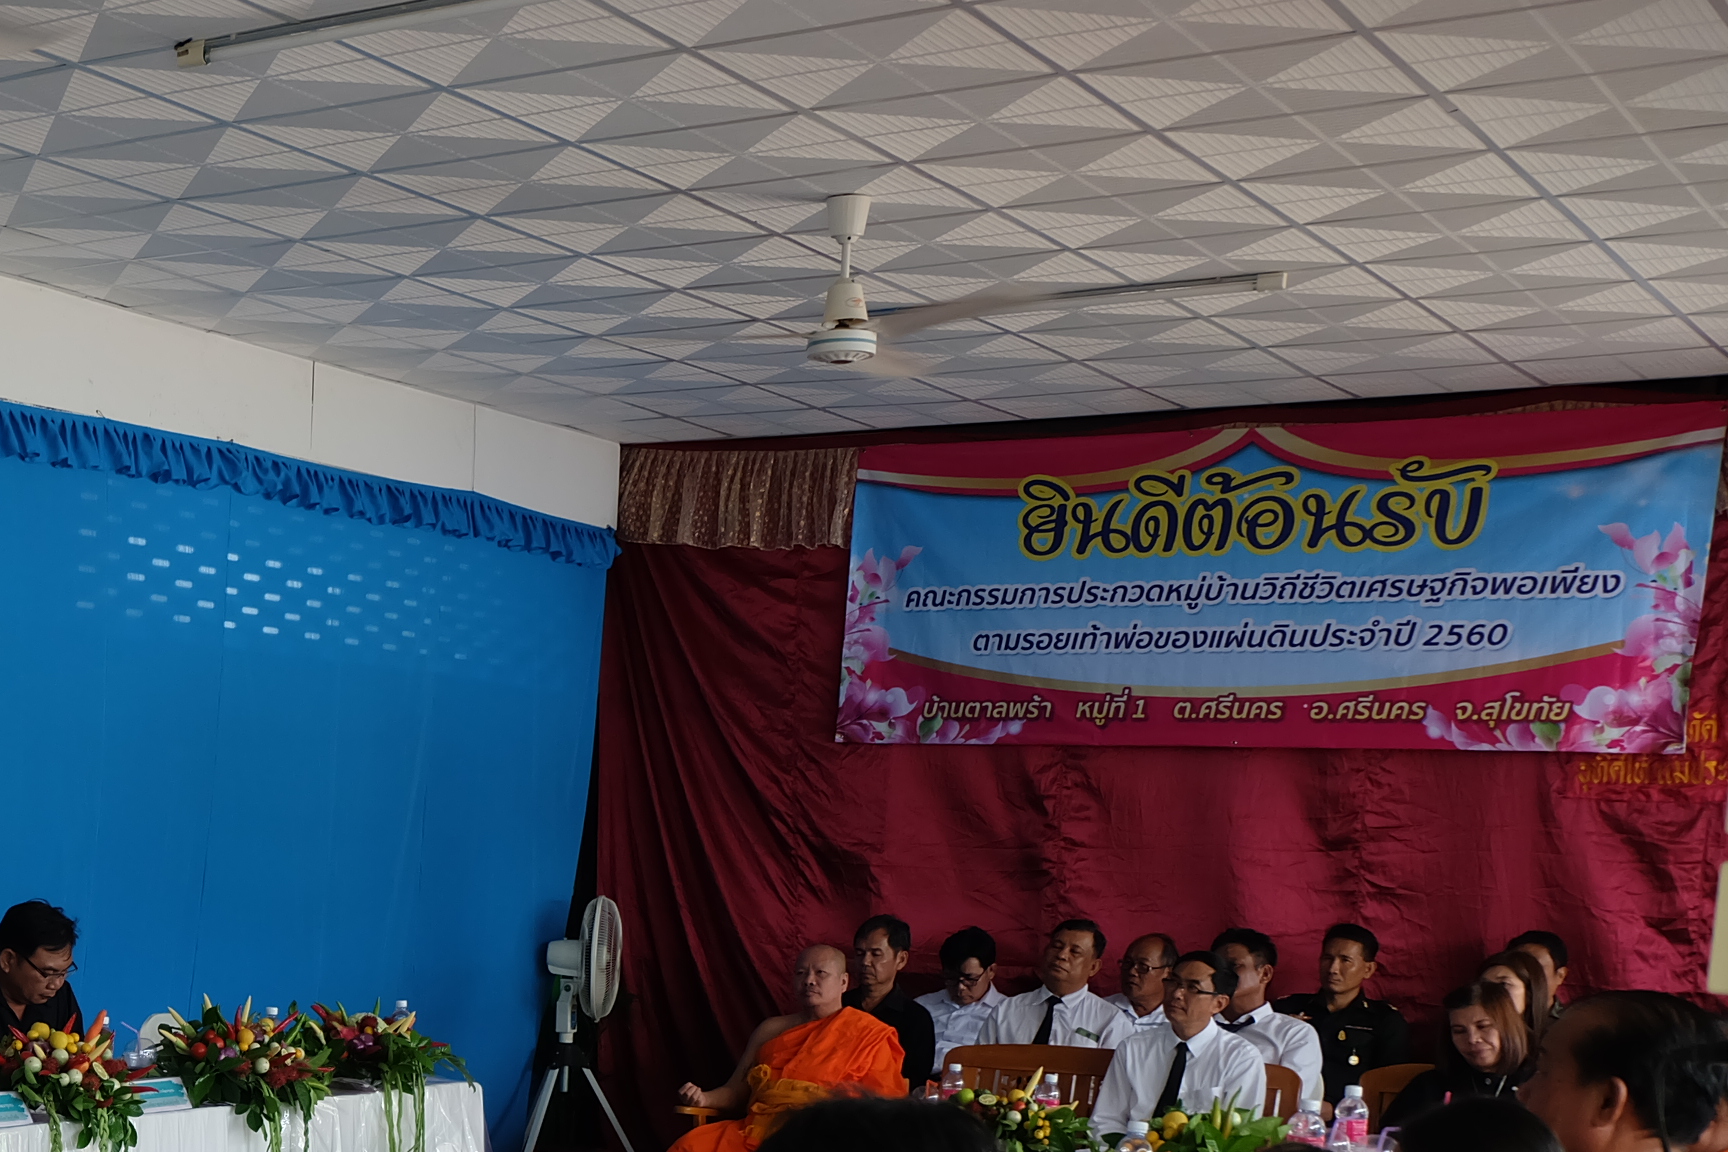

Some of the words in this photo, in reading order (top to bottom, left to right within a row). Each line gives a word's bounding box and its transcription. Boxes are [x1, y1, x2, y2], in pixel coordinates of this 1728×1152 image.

[1018, 455, 1499, 563] ยินดีต้อนรับ
[904, 563, 1625, 614] คณะกรรมการประกวดหมู่บ้านวิถีชีวิตเศรษฐกิจพอเพียง
[971, 617, 1418, 656] ตามรอยเท้าพ่อของแผ่นดินประจำปี
[1421, 621, 1512, 650] 2560
[922, 693, 1053, 722] บ้านตาลพร้า
[1076, 688, 1129, 726] หมู่ที่
[1131, 698, 1146, 720] 1
[1172, 694, 1284, 722] ต.ศรีนคร
[1309, 693, 1427, 722] อ.ศรีนคร
[1454, 692, 1572, 729] จ.สุโขทัย
